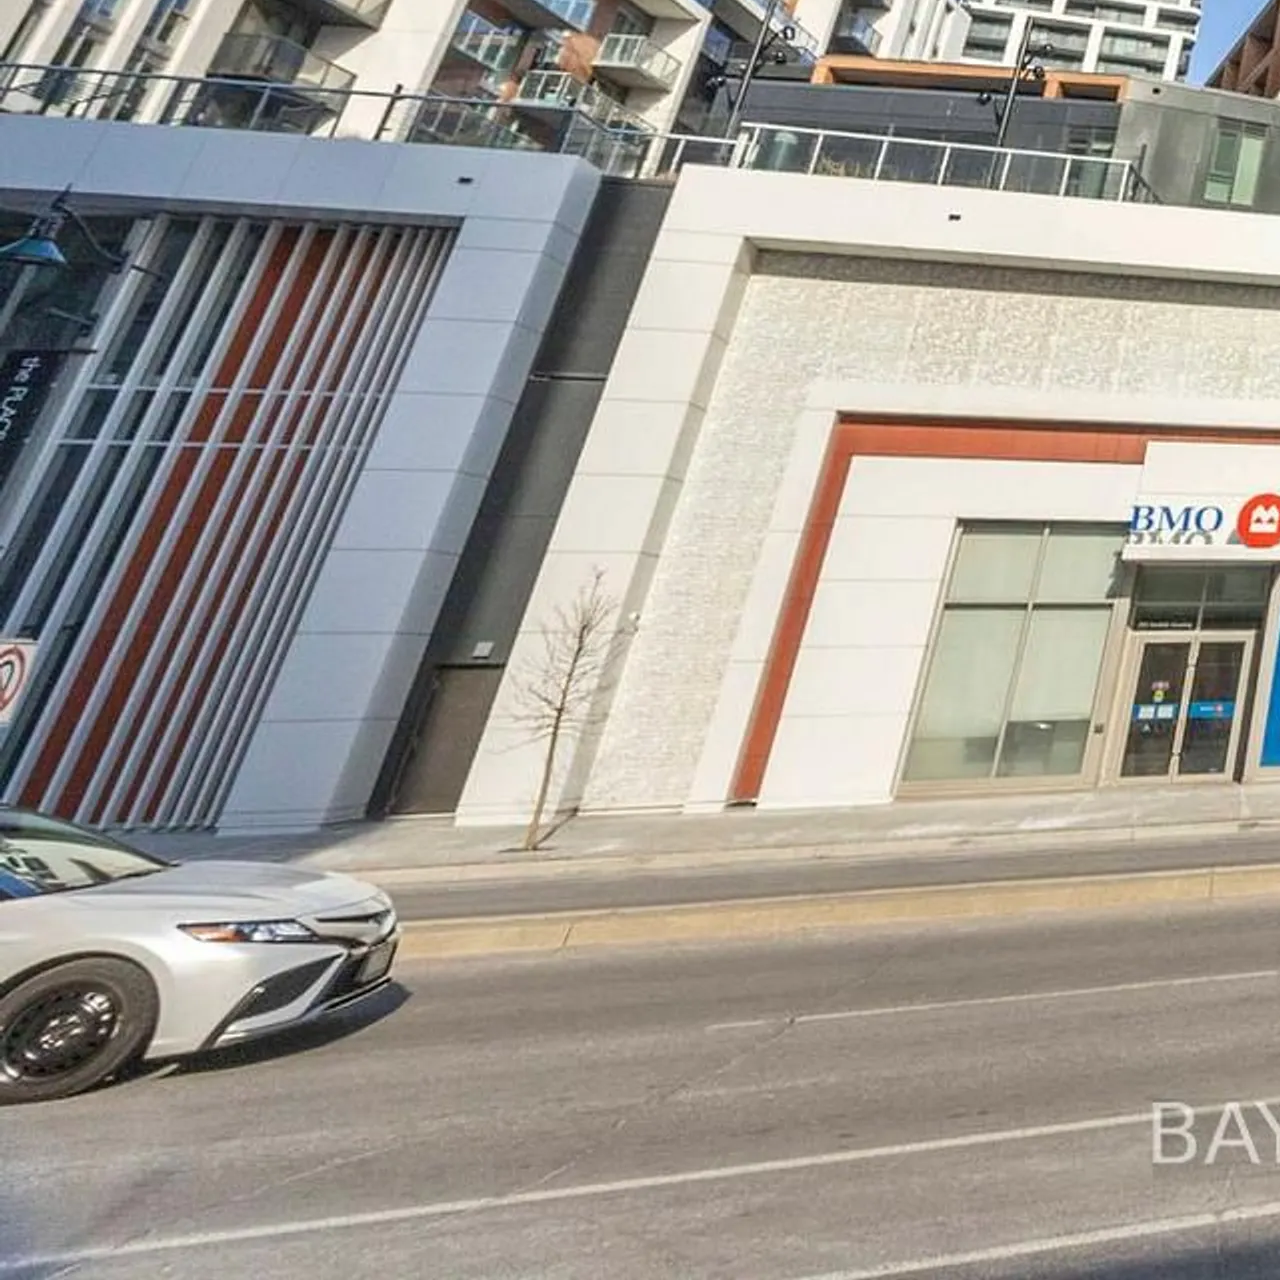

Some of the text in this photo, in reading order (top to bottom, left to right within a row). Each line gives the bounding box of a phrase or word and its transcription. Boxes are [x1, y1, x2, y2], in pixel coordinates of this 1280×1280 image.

[0, 356, 42, 441] the PLAC
[1131, 504, 1224, 532] BMO
